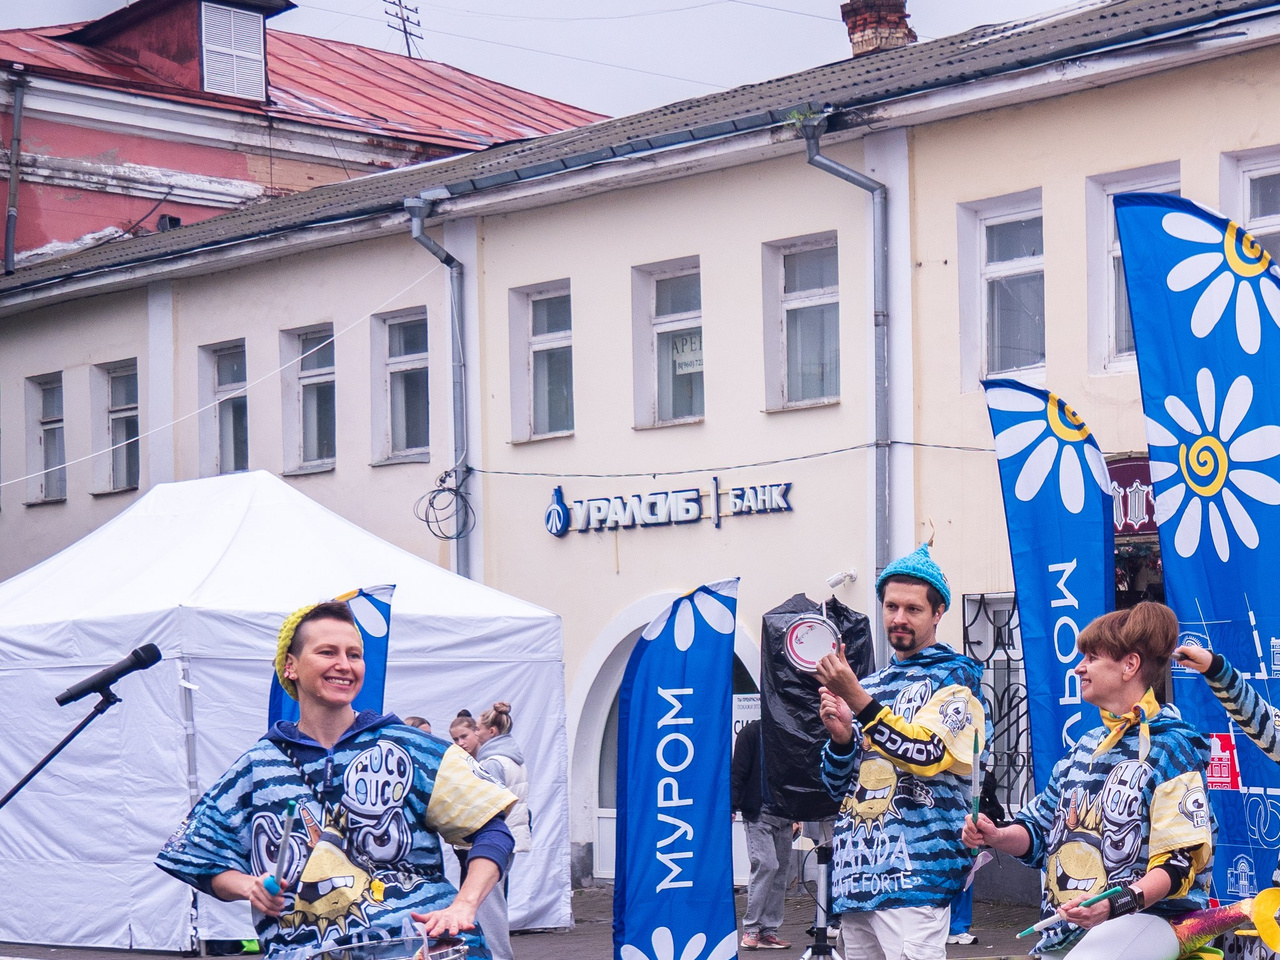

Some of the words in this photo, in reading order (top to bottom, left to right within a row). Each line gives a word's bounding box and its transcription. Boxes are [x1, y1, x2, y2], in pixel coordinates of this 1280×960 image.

[572, 488, 700, 533] УРАЛСИБ
[728, 482, 793, 516] БАНК
[656, 686, 694, 893] МУРОМ
[1111, 764, 1148, 792] BLOC
[833, 831, 913, 873] BANDA
